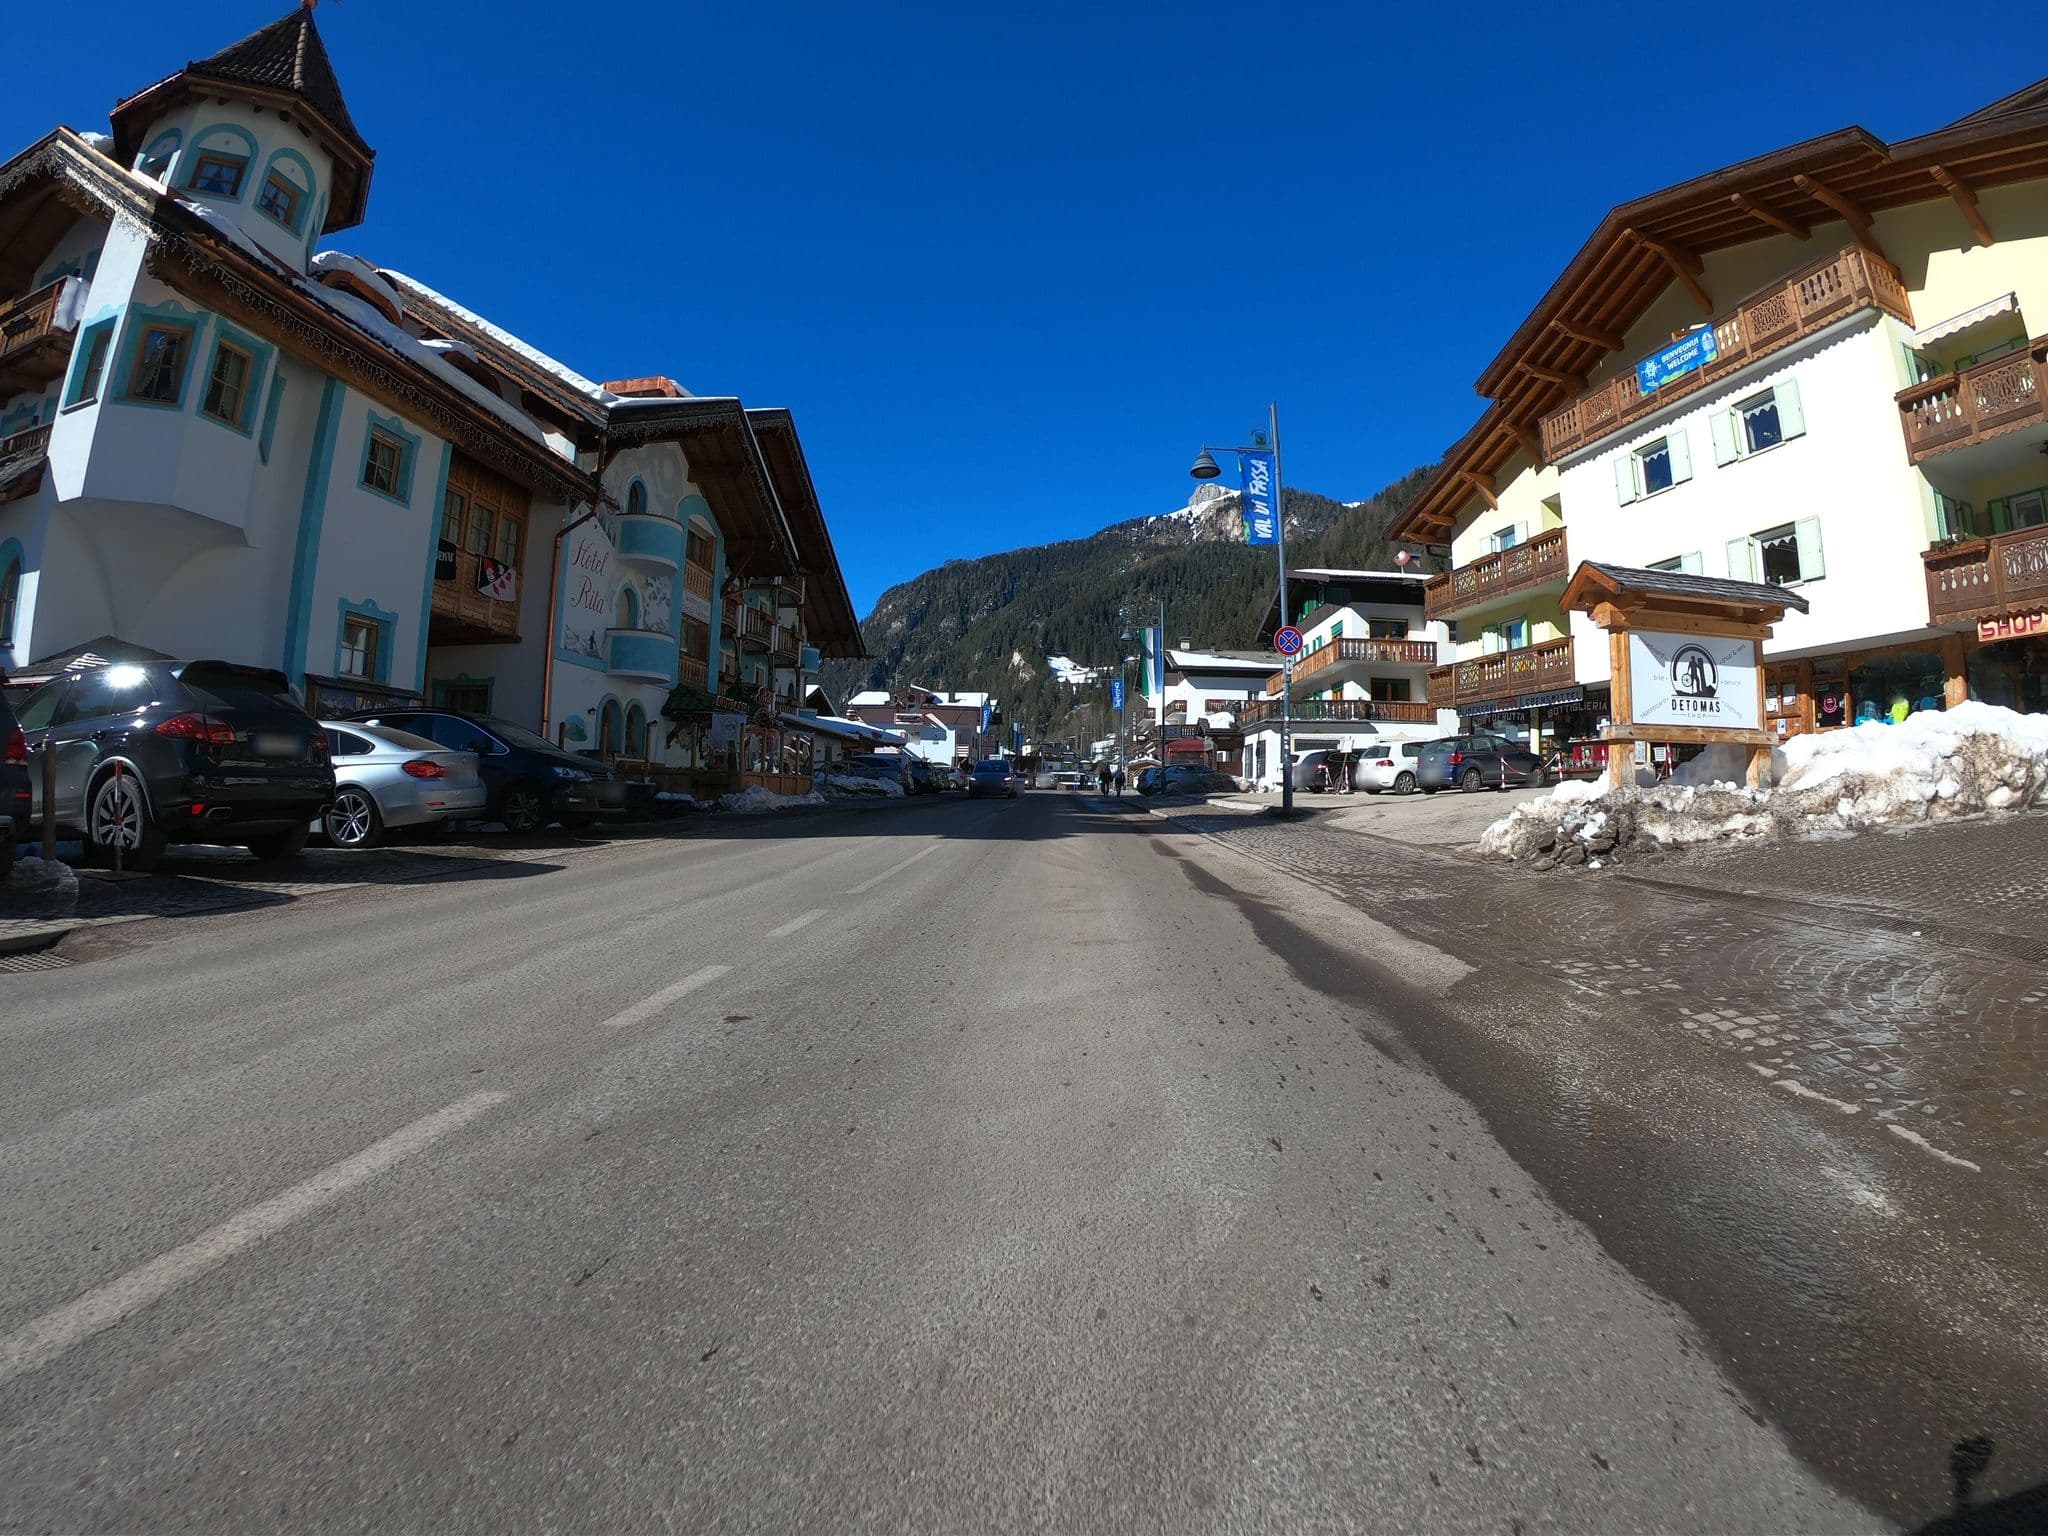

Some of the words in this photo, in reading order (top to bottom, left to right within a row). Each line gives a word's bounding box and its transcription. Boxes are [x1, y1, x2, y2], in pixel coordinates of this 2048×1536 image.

[1667, 348, 1699, 370] WELCOME
[1249, 459, 1269, 497] FASSA
[1254, 518, 1272, 538] VAL
[571, 538, 609, 577] Hotel
[570, 575, 605, 614] Rita
[1980, 611, 2043, 639] SHOP
[1519, 691, 1581, 707] LEBENSMITTEL
[1547, 701, 1607, 718] BOTTIGLIERIA
[1672, 699, 1720, 713] DETOMAS
[1477, 712, 1525, 725] ORTOFRUTTA
